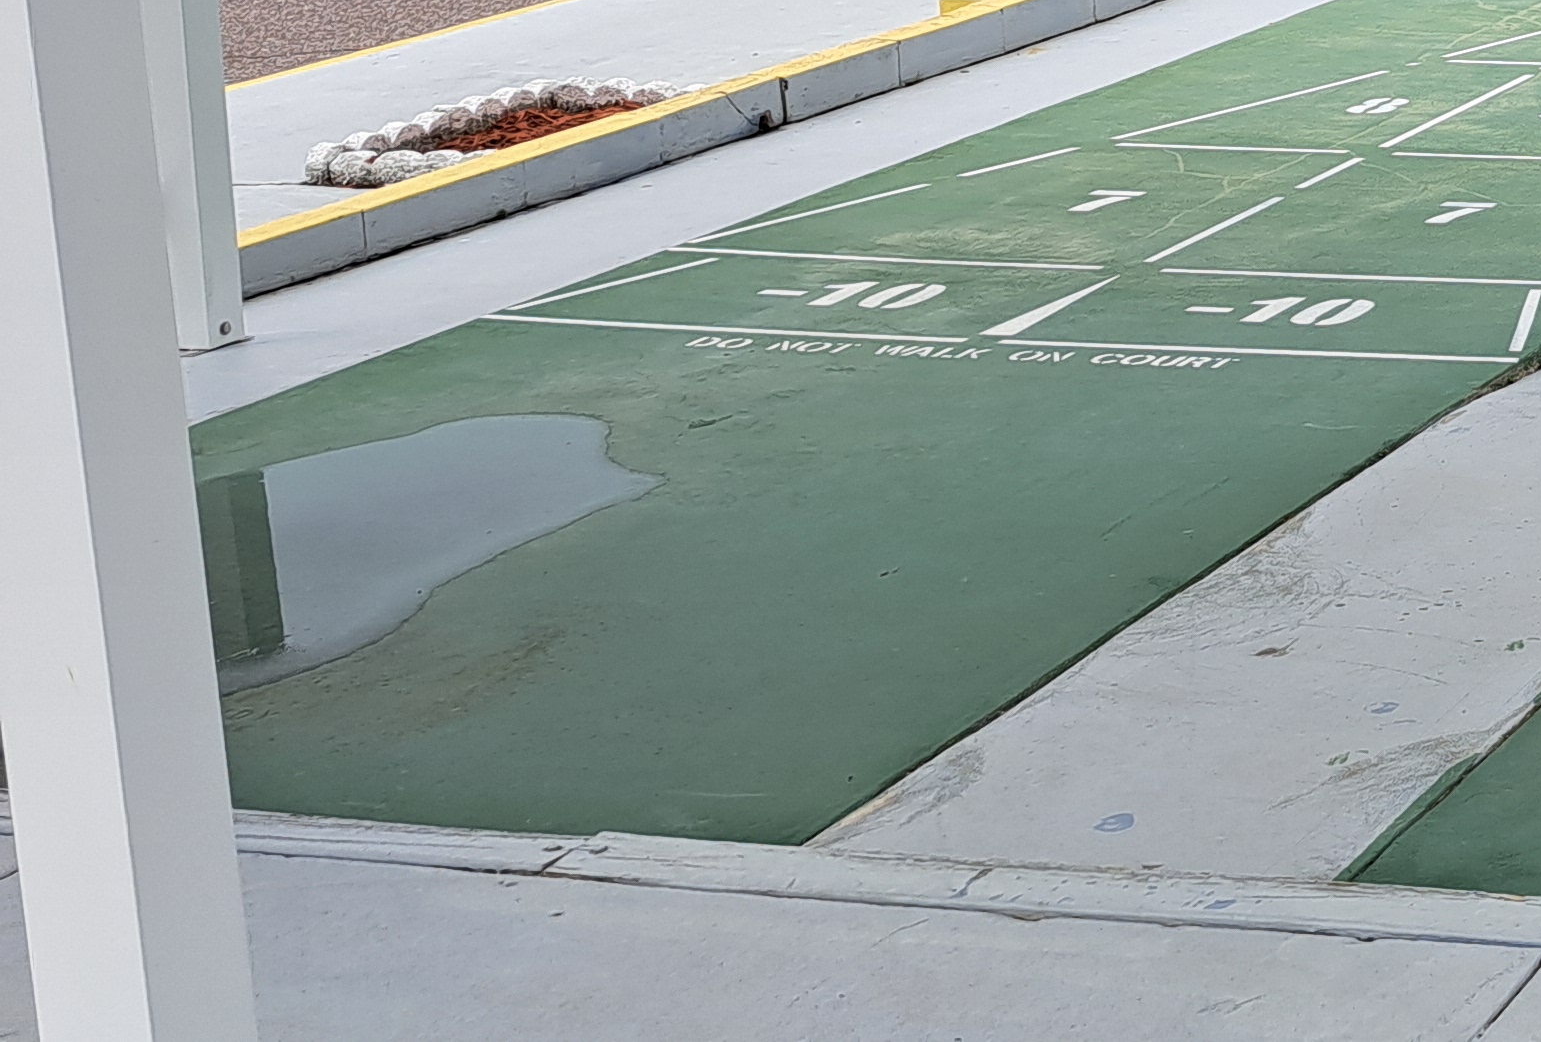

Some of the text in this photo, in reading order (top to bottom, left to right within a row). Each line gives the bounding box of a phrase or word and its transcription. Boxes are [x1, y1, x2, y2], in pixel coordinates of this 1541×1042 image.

[1346, 97, 1409, 114] 8
[1067, 190, 1147, 212] 7
[1424, 201, 1497, 224] 7
[757, 281, 948, 309] -10
[1185, 296, 1376, 326] -10
[684, 336, 1241, 369] DO NOT WALK ON COURT
